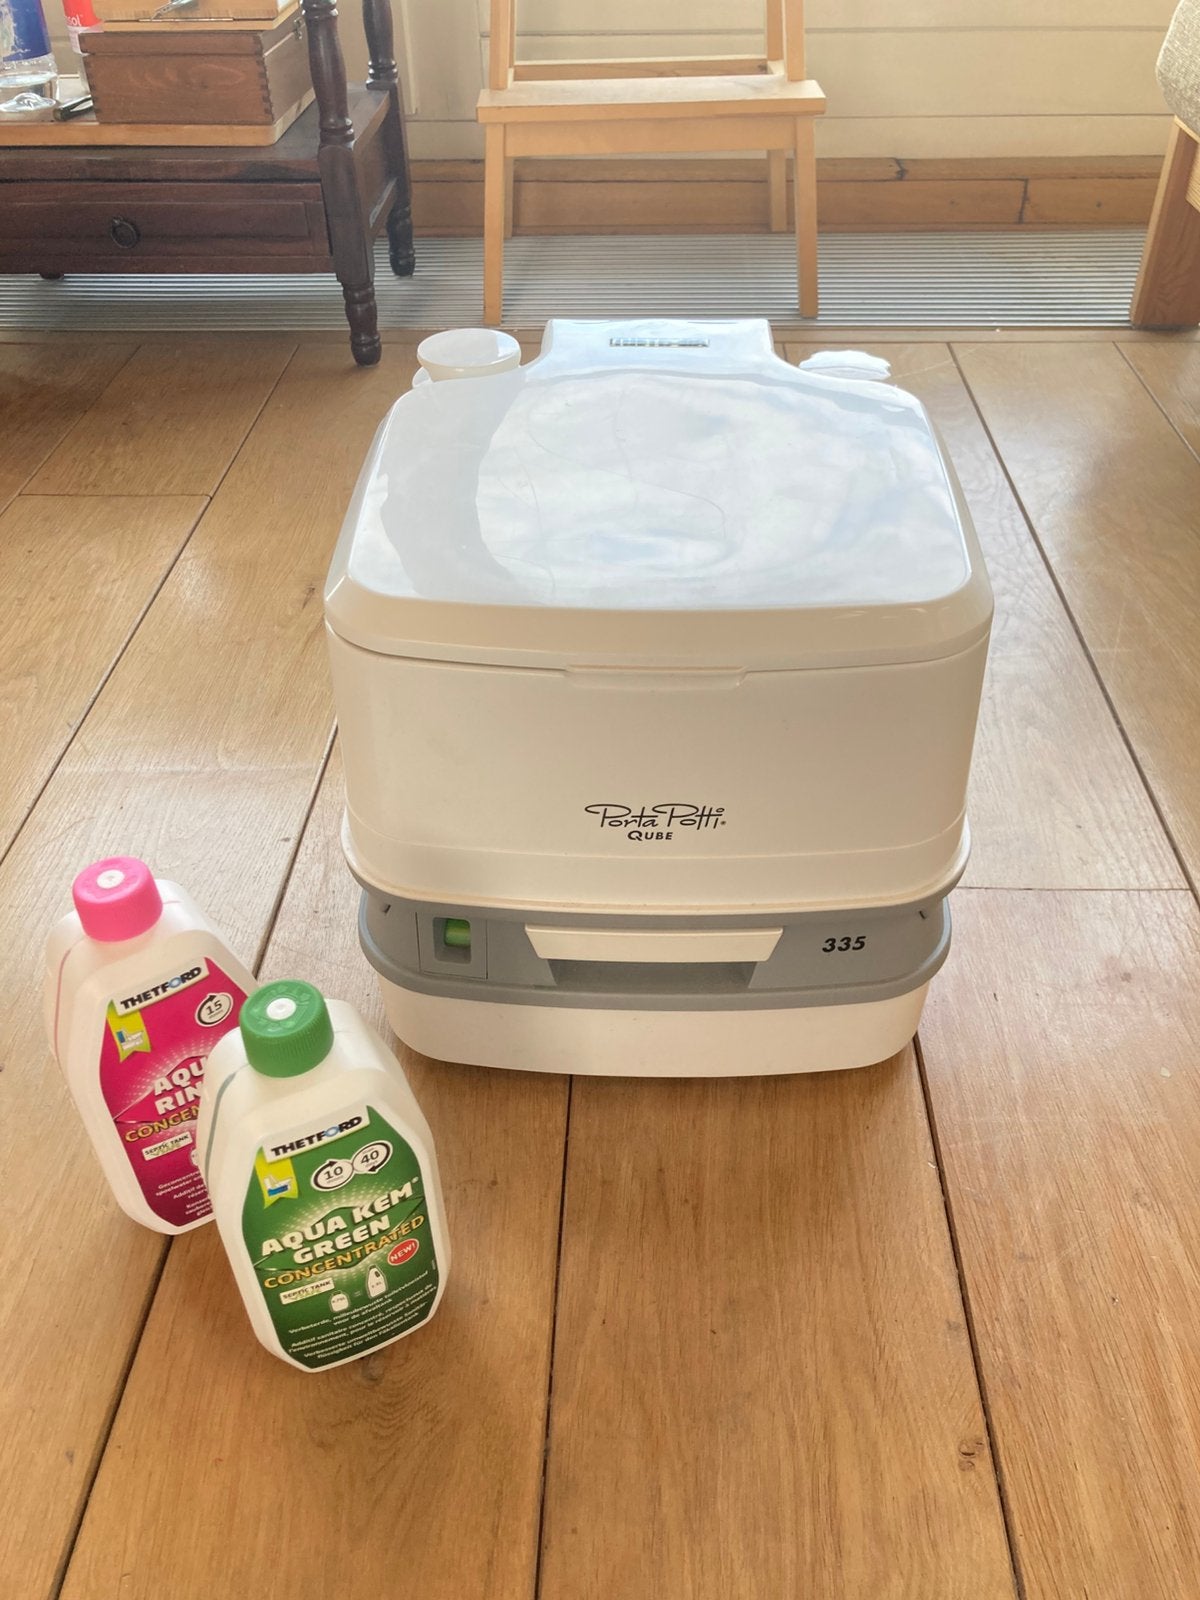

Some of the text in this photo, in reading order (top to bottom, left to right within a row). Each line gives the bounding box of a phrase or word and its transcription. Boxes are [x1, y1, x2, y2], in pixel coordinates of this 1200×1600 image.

[584, 803, 659, 828] Porta
[627, 830, 674, 842] QUBE
[822, 935, 867, 953] 335
[120, 966, 202, 1010] THETFORD
[206, 1000, 222, 1015] 15
[144, 1142, 169, 1155] SEPTIC
[170, 1134, 189, 1145] TANK
[270, 1116, 363, 1157] THETFORD
[360, 1150, 379, 1164] 40
[324, 1166, 343, 1180] 10
[262, 1215, 347, 1256] AQUA
[293, 1215, 390, 1264] GREEN
[264, 1215, 425, 1289] CONCENTRATED
[390, 1243, 416, 1262] NEW!
[283, 1287, 309, 1299] SEPTIC
[310, 1280, 331, 1291] TANK
